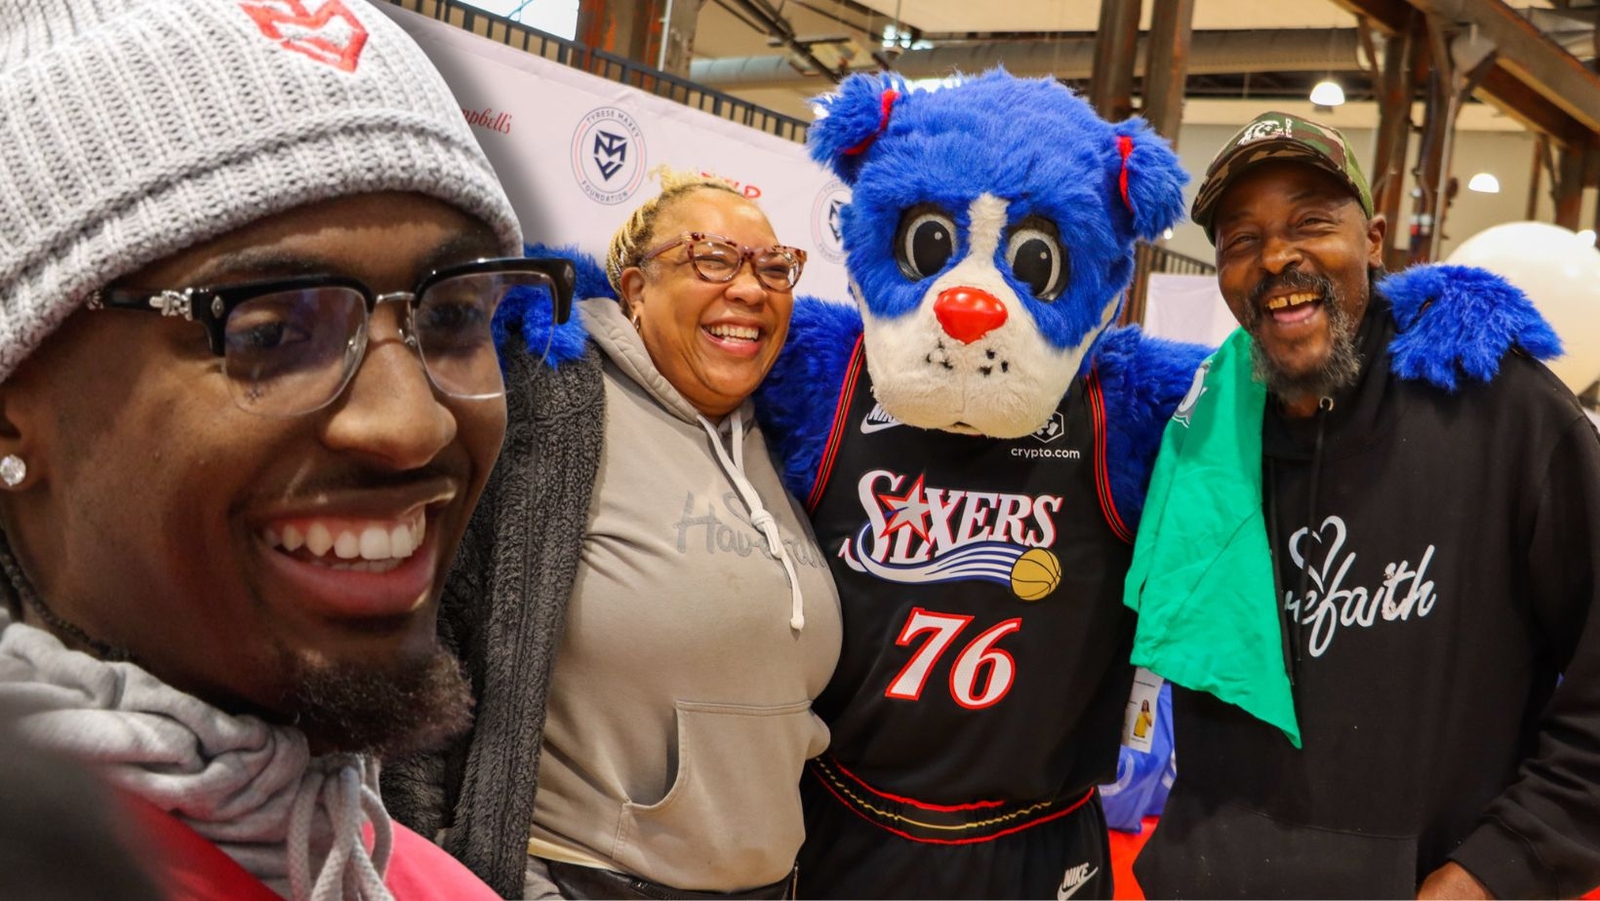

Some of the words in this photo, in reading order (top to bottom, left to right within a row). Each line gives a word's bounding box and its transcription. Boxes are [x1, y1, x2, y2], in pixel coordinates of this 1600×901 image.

[586, 110, 615, 124] TYRESE
[618, 113, 639, 138] MAXEY
[581, 180, 628, 203] FOUNDATION
[1010, 446, 1081, 460] crypto.com
[884, 606, 1023, 710] 76
[1062, 862, 1090, 889] NIKE
